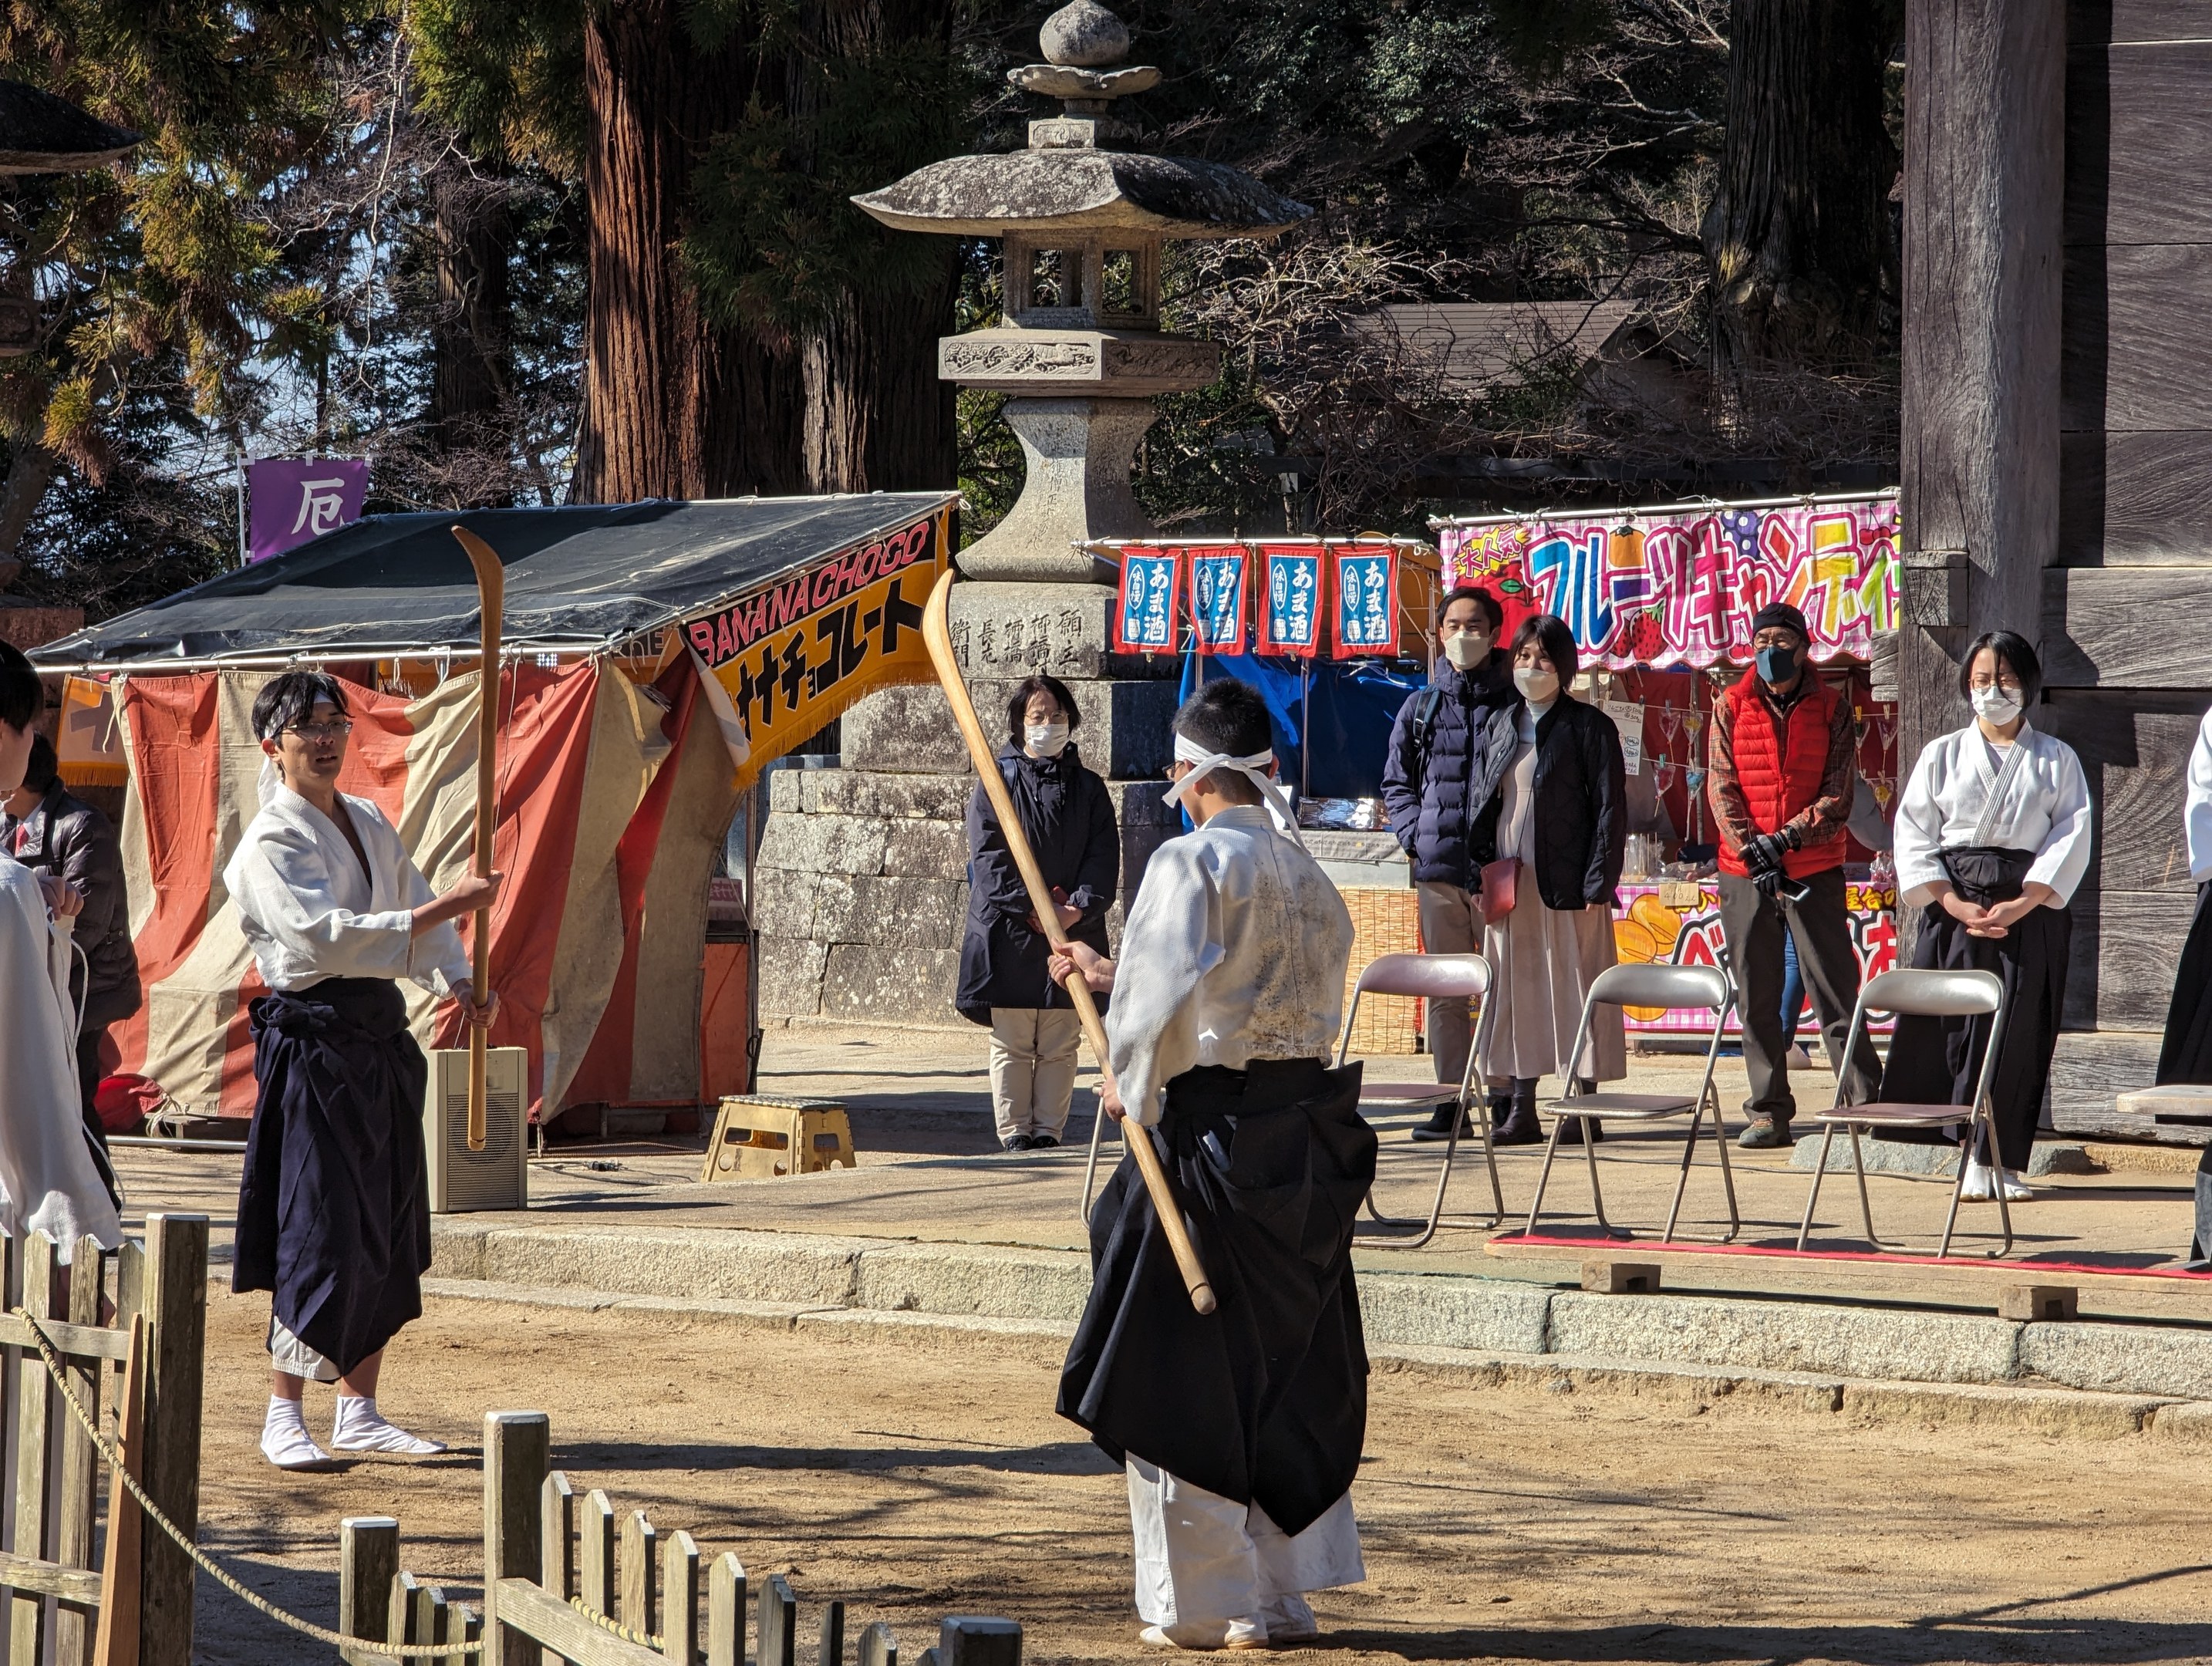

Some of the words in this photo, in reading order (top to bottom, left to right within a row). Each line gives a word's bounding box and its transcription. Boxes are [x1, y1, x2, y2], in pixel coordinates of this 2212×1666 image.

[291, 477, 345, 536] 厄
[1460, 526, 1522, 578] 大人気
[1528, 518, 1900, 649] フルーツキャンディ
[1144, 562, 1169, 642] あま酒
[1213, 562, 1236, 643] あま酒
[1288, 562, 1313, 641] あま酒
[1363, 562, 1387, 641] あま酒
[728, 577, 924, 743] ナナチョコレート
